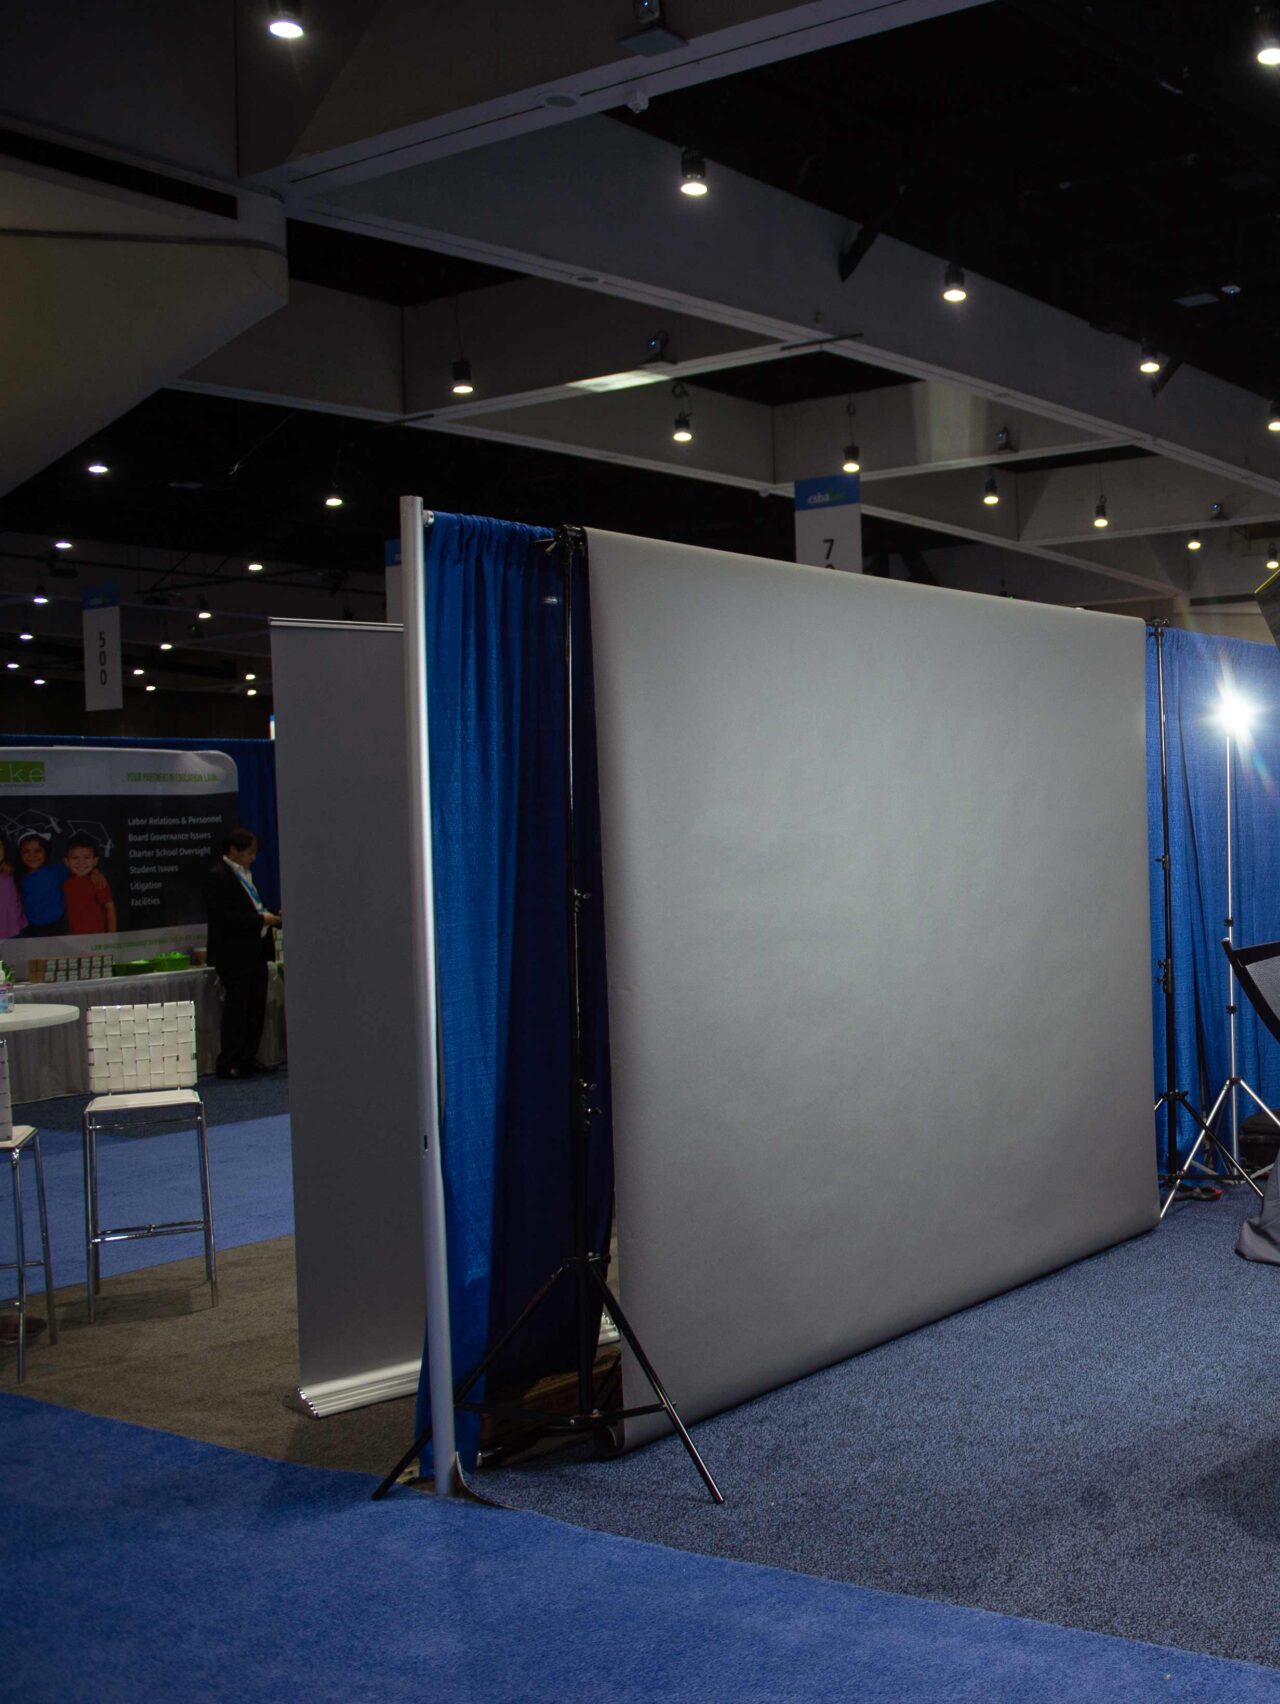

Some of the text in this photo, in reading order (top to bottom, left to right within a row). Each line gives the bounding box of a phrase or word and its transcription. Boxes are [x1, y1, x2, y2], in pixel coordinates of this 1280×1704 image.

[98, 631, 107, 686] 500
[127, 814, 222, 826] Labor Relations & Personnel
[128, 831, 212, 842] Board Governance Issues
[128, 846, 211, 858] Charter School Oversight
[129, 864, 179, 874] Student Issues
[130, 880, 162, 892] Litigation
[131, 896, 160, 907] Facilities
